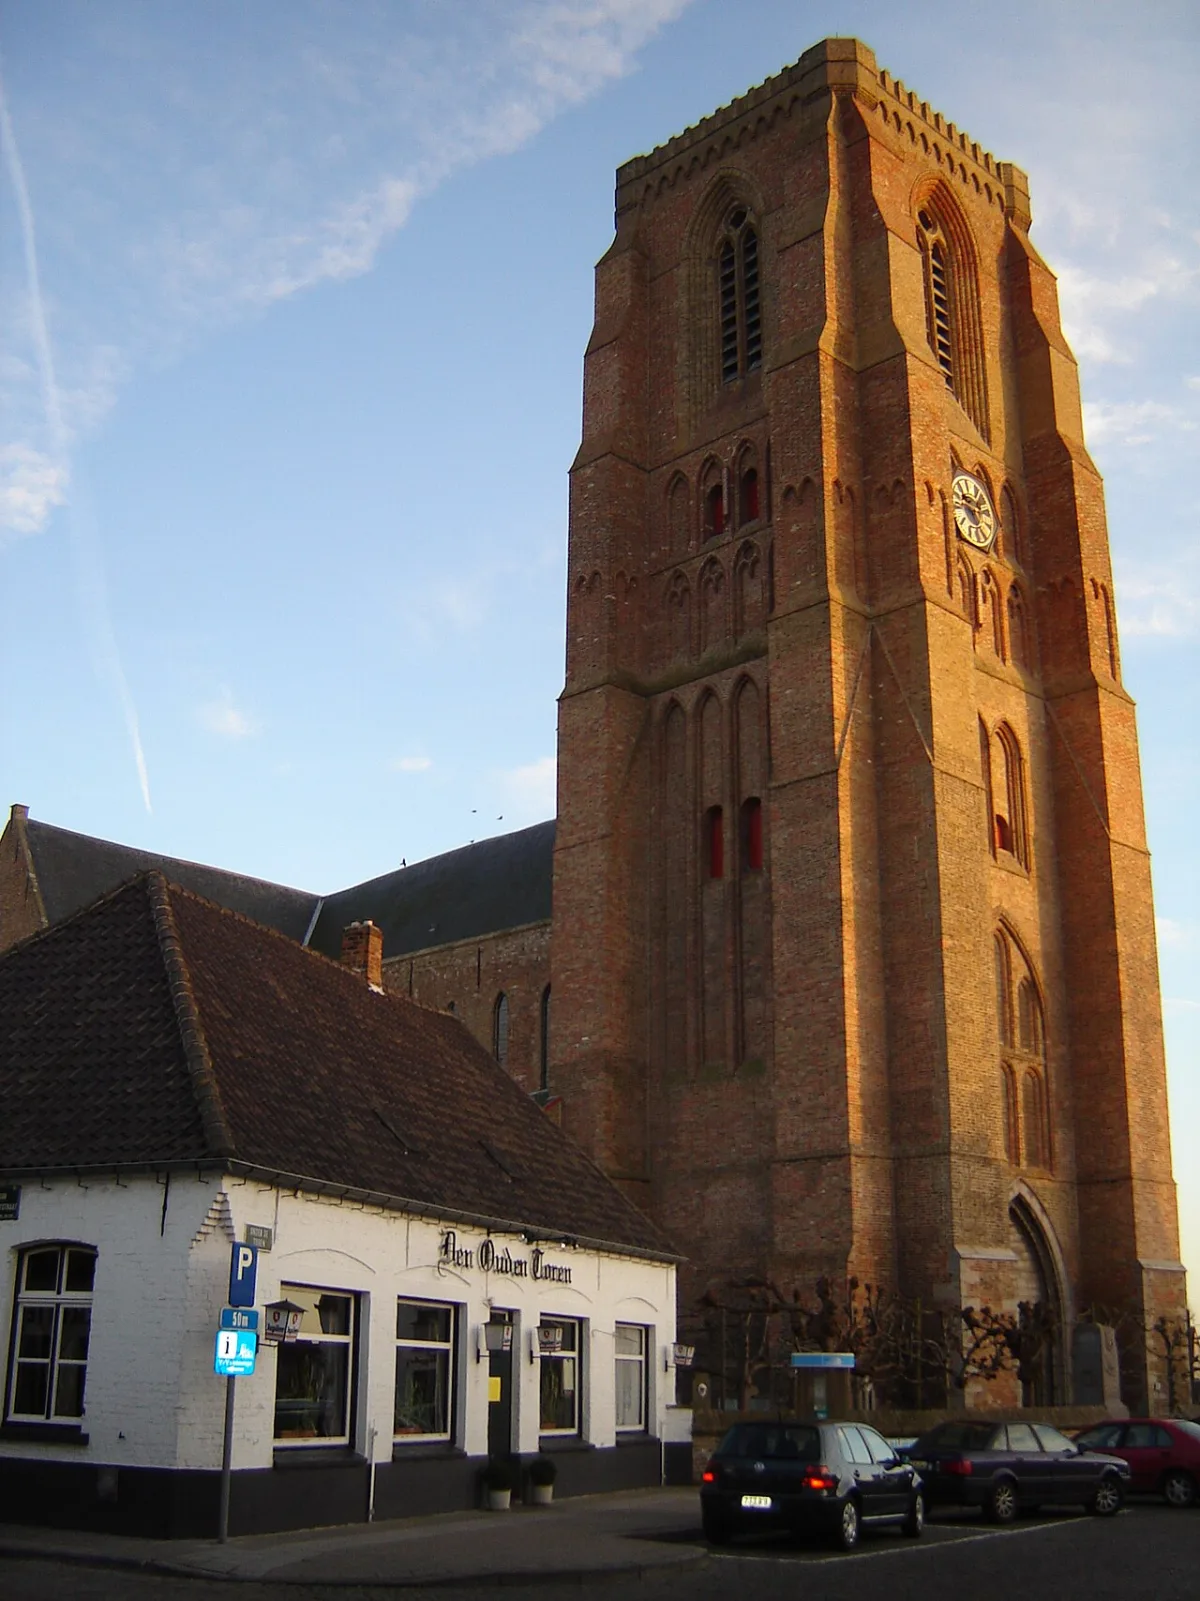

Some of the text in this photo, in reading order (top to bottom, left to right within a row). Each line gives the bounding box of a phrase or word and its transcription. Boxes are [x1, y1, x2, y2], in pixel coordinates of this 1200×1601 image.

[237, 1247, 253, 1280] P
[438, 1231, 572, 1283] Den Ouden Toren
[232, 1312, 249, 1327] 50m
[224, 1336, 229, 1354] i
